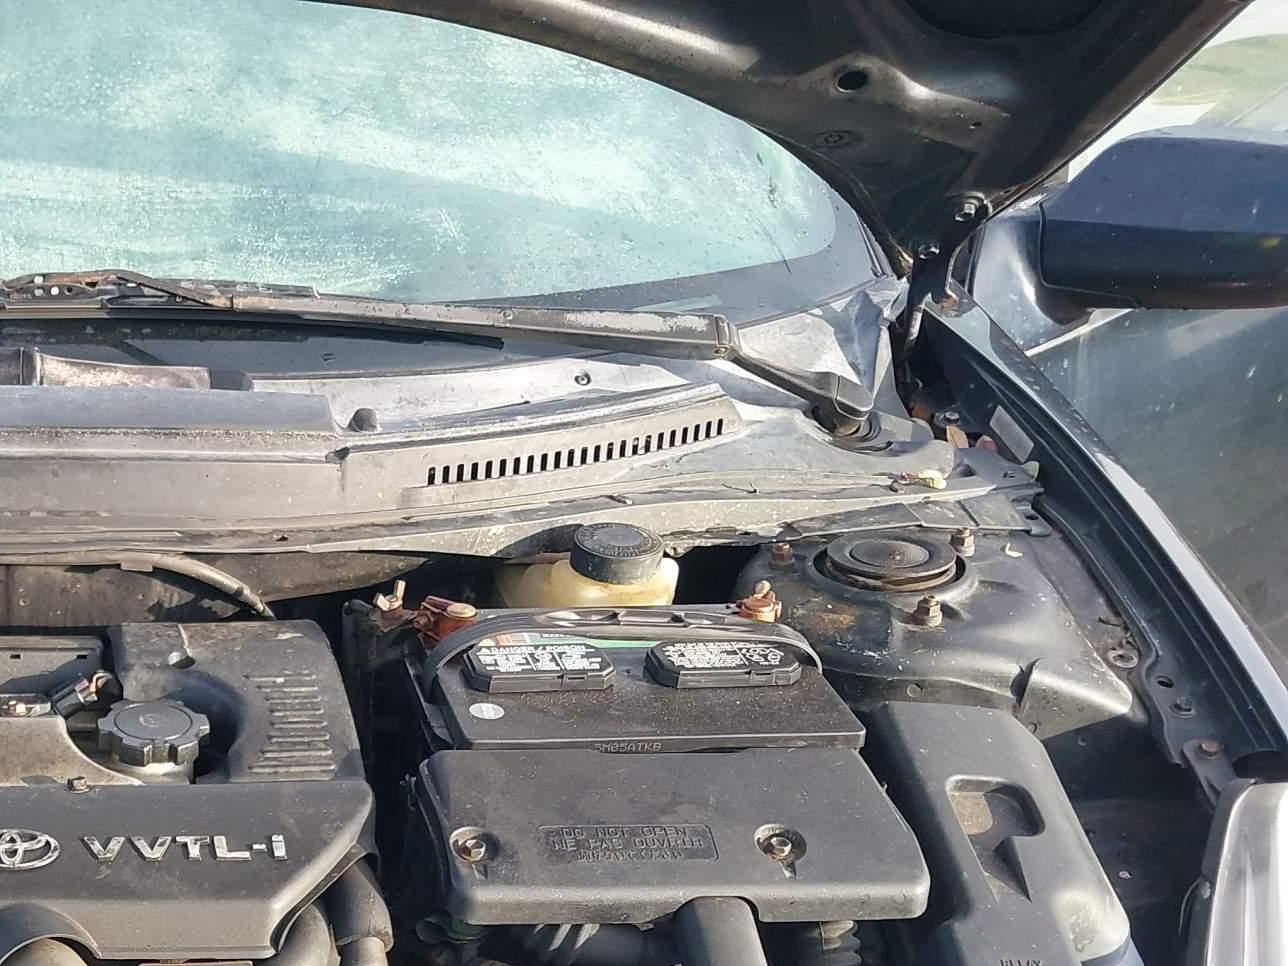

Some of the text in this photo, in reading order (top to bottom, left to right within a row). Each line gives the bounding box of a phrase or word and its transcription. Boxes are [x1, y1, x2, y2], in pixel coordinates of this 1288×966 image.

[596, 826, 630, 838] NOT
[641, 826, 687, 838] OPEN
[83, 834, 288, 862] VVTL-i
